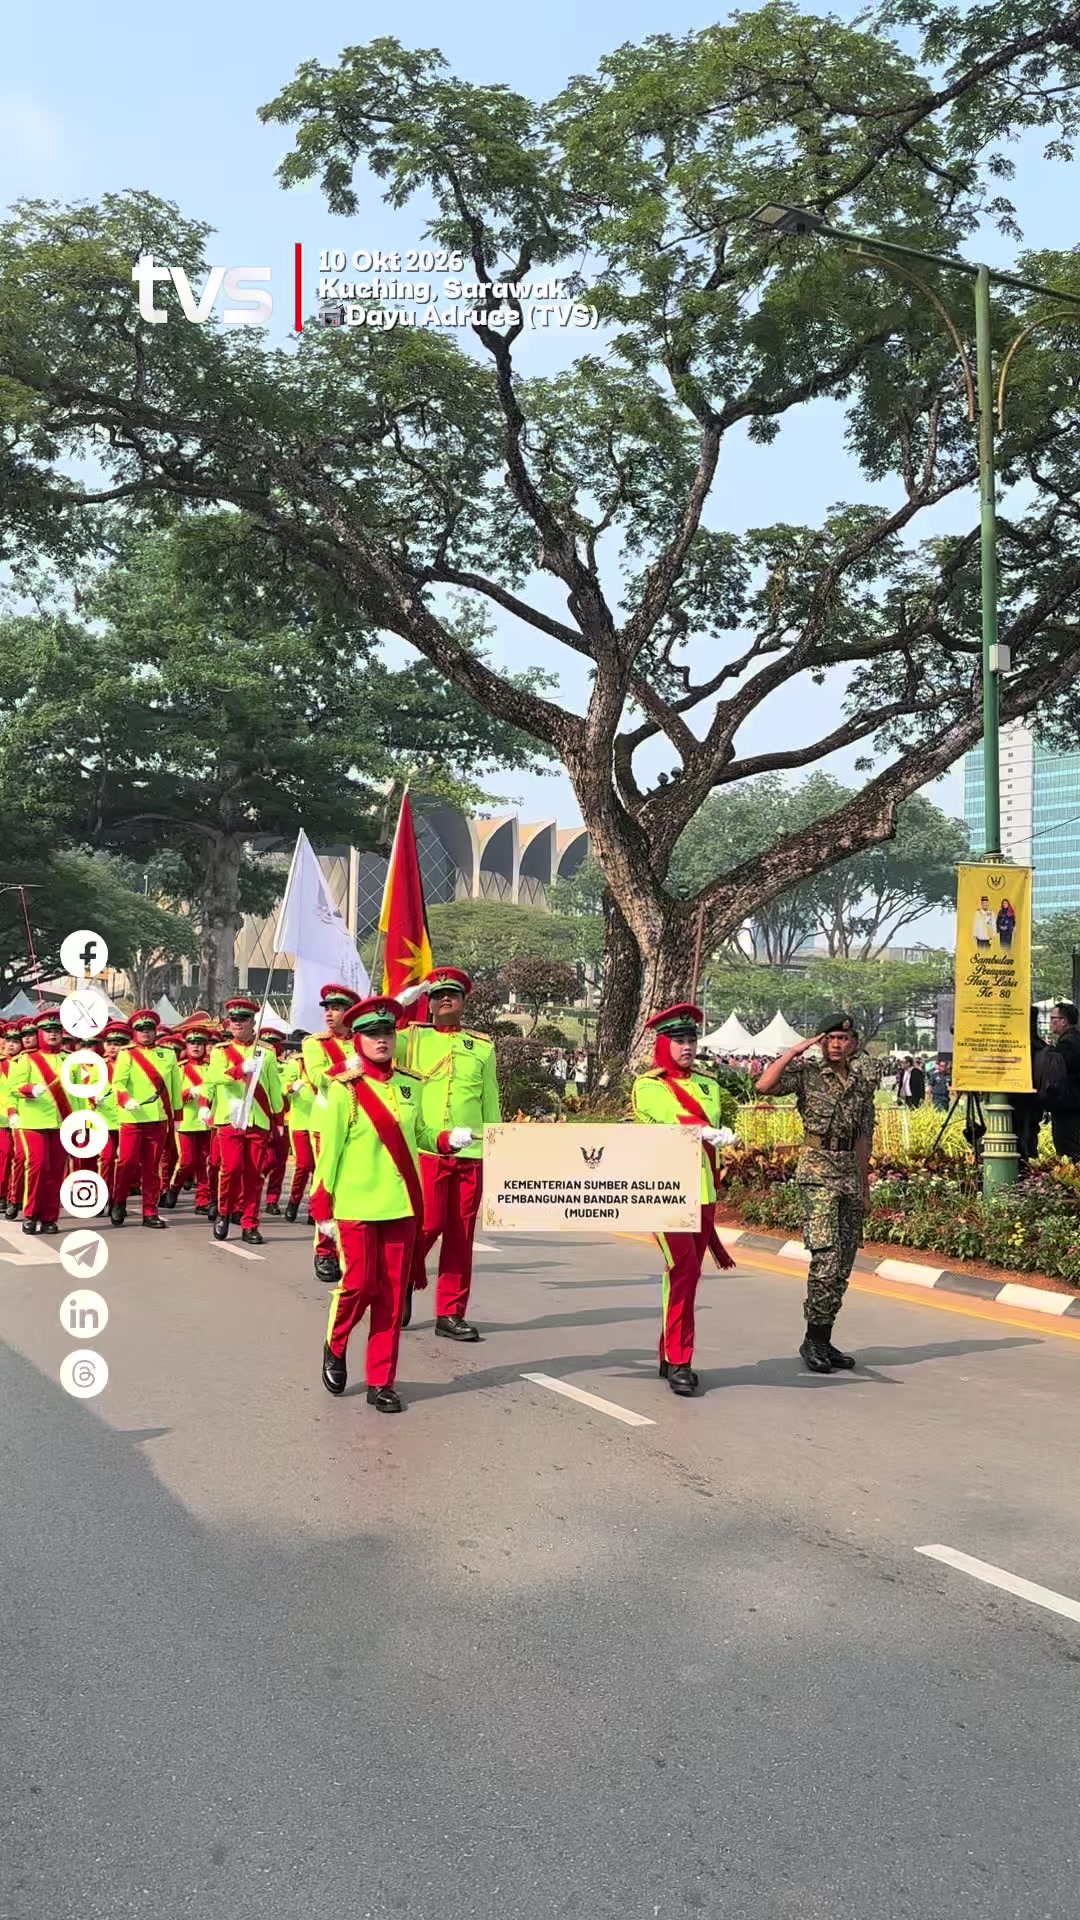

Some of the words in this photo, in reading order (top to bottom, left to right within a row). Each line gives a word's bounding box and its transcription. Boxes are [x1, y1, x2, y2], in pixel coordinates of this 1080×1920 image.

[504, 1180, 582, 1190] KEMENTERIAN
[583, 1180, 628, 1190] SUMBER
[631, 1180, 655, 1190] ASLI
[657, 1180, 680, 1190] DAN
[497, 1194, 582, 1204] PEMBANGUNAN
[583, 1194, 628, 1204] BANDAR
[631, 1194, 686, 1204] SARAWAK
[564, 1208, 620, 1219] (MUDENR)
